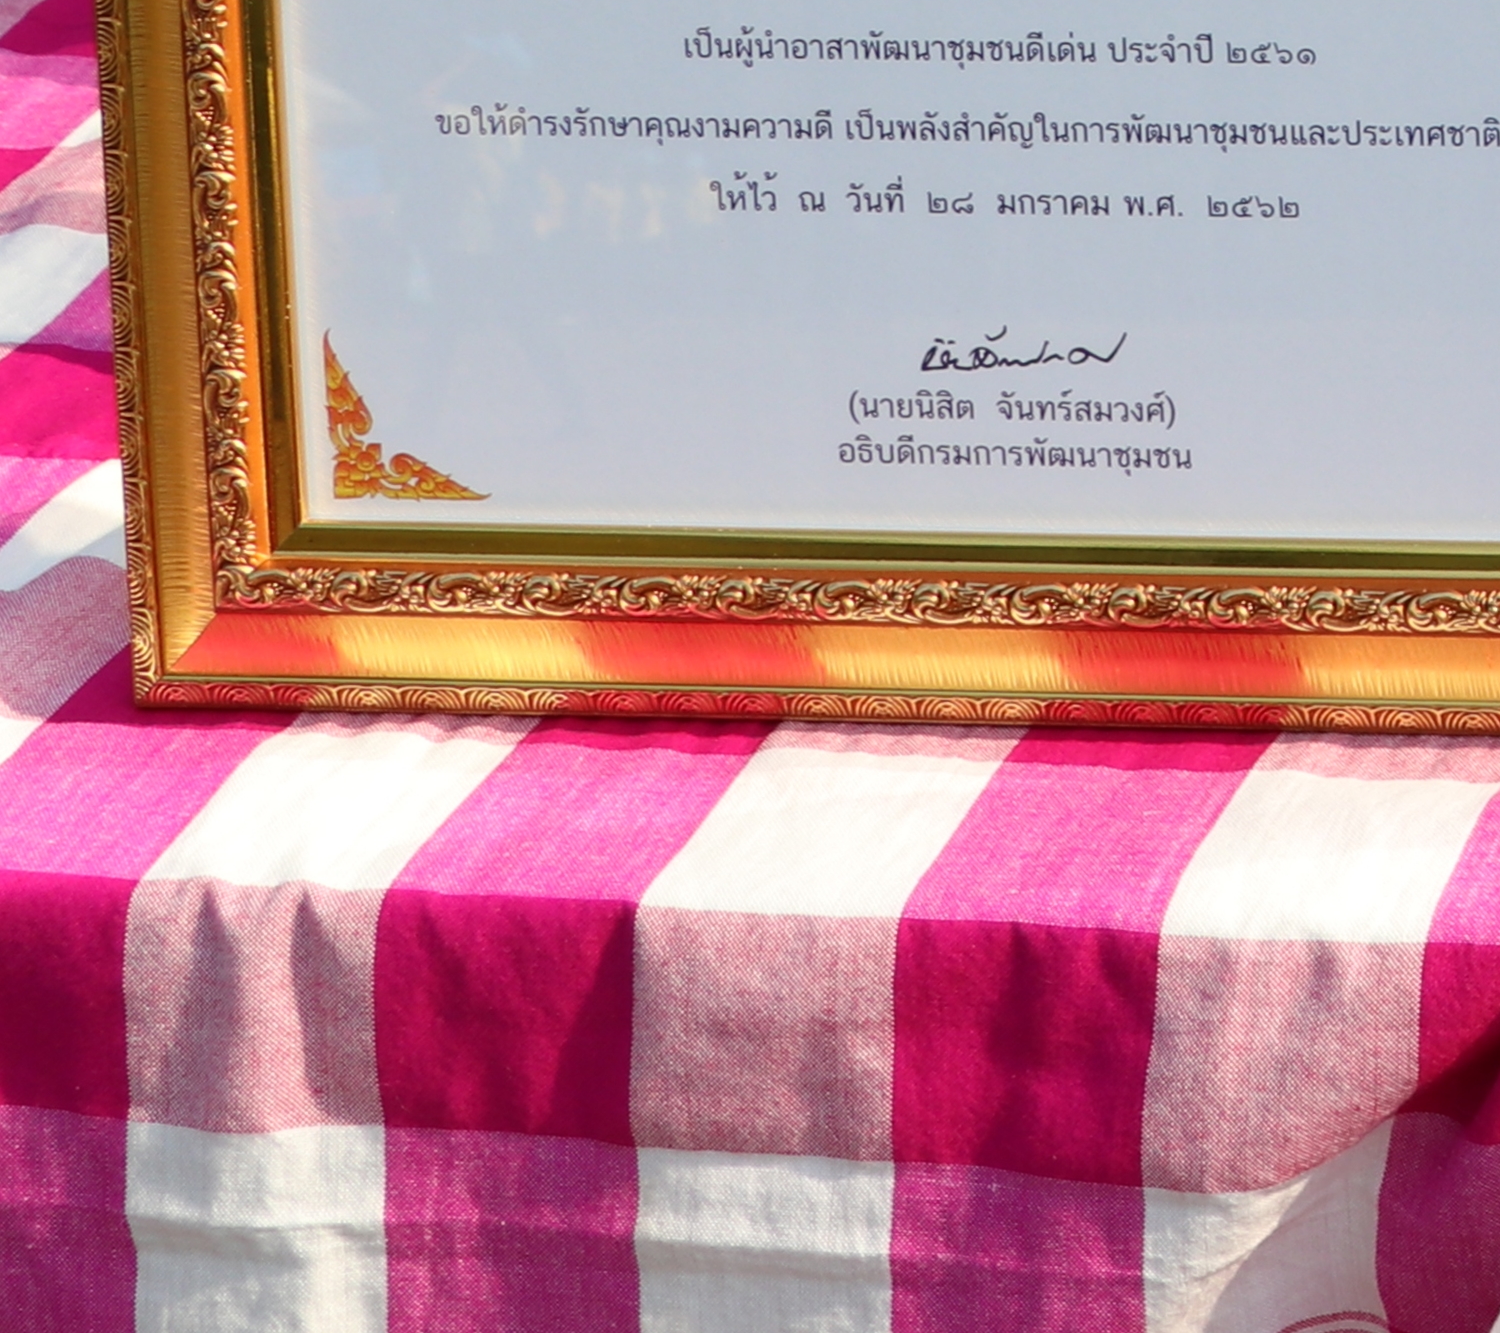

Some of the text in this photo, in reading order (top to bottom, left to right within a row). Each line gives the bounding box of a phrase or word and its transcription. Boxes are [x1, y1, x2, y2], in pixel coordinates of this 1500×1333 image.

[1106, 32, 1214, 64] ประจำปี
[1225, 41, 1317, 66] ๒๕๖๑
[709, 170, 1300, 219] ให้ไว้ ณ วันที่ ๒๘ มกราคม พ.ศ. ๒๕๖๒
[848, 388, 1177, 431] (นายนิสิต จันทร์สมวงศ์)
